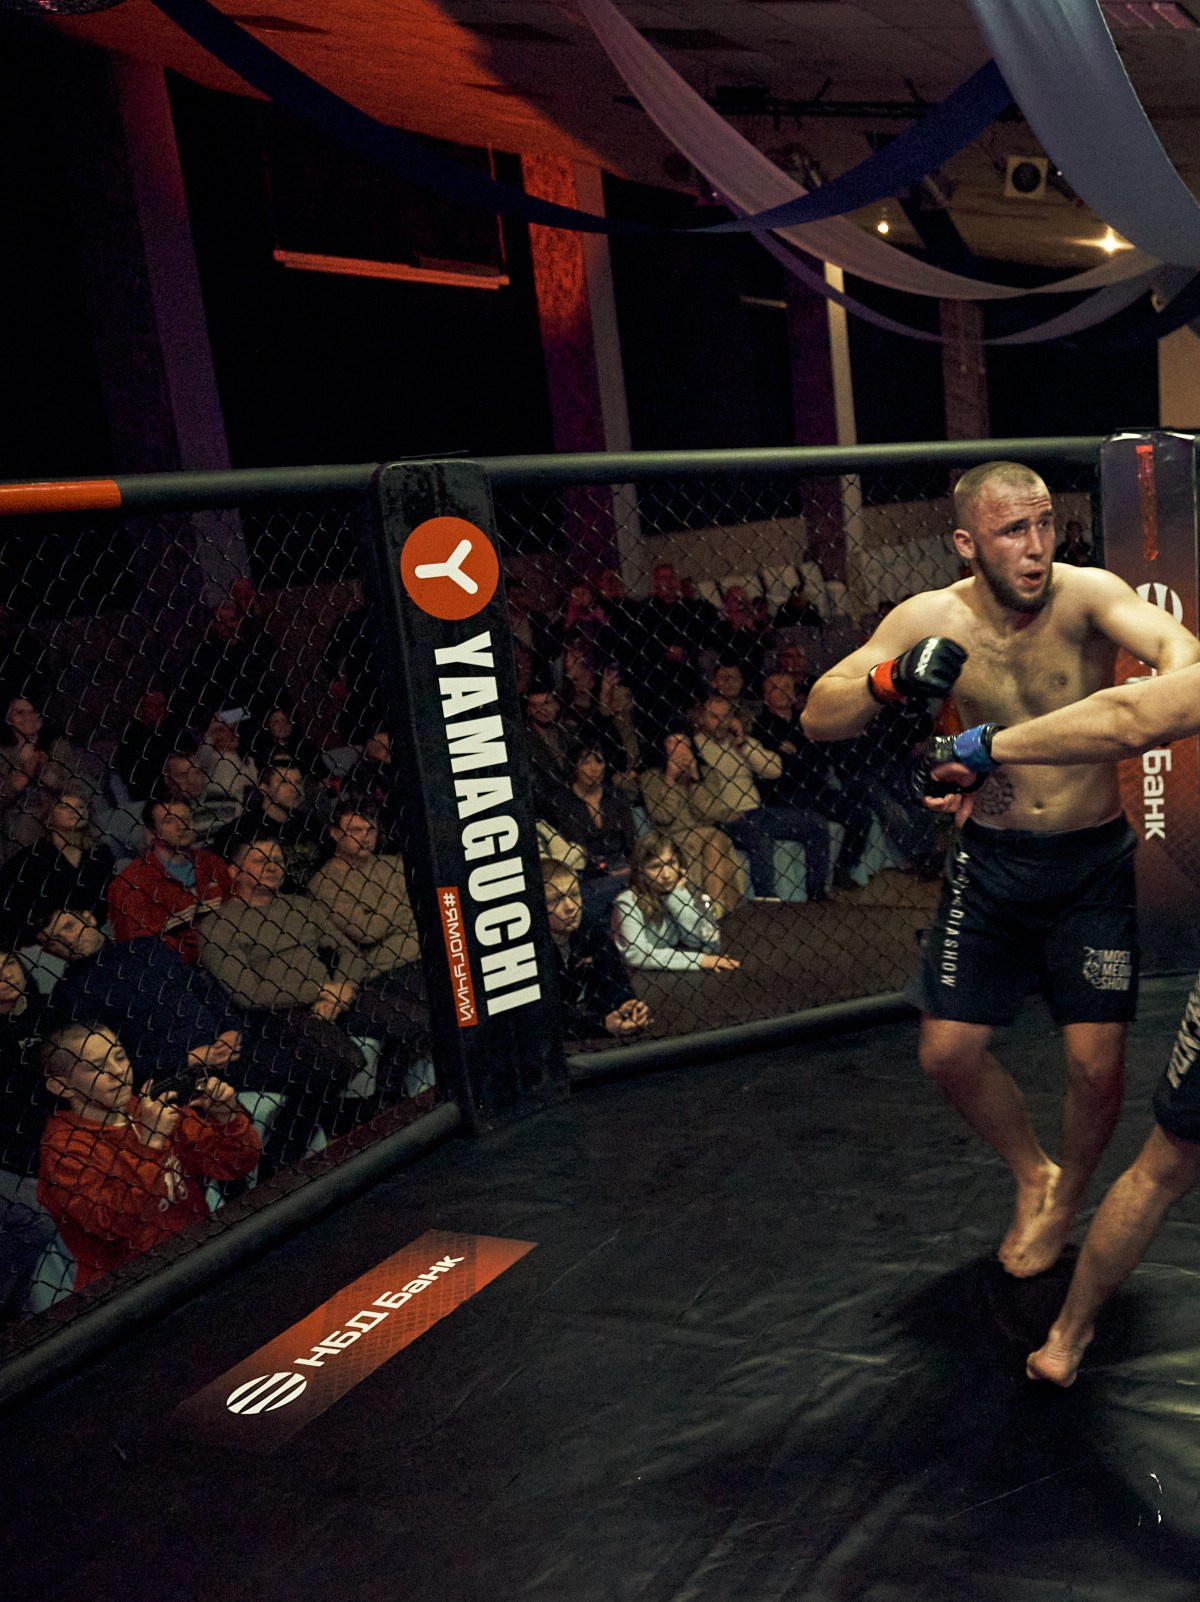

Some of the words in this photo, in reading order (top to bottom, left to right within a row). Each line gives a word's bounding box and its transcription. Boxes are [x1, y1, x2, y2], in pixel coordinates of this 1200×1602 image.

[434, 631, 542, 1017] YAMAGUCHI
[1142, 749, 1173, 840] Банк
[442, 891, 474, 1022] #ЯМОГУЧИЙ
[293, 1310, 389, 1367] НБД
[372, 1255, 465, 1309] Банк
